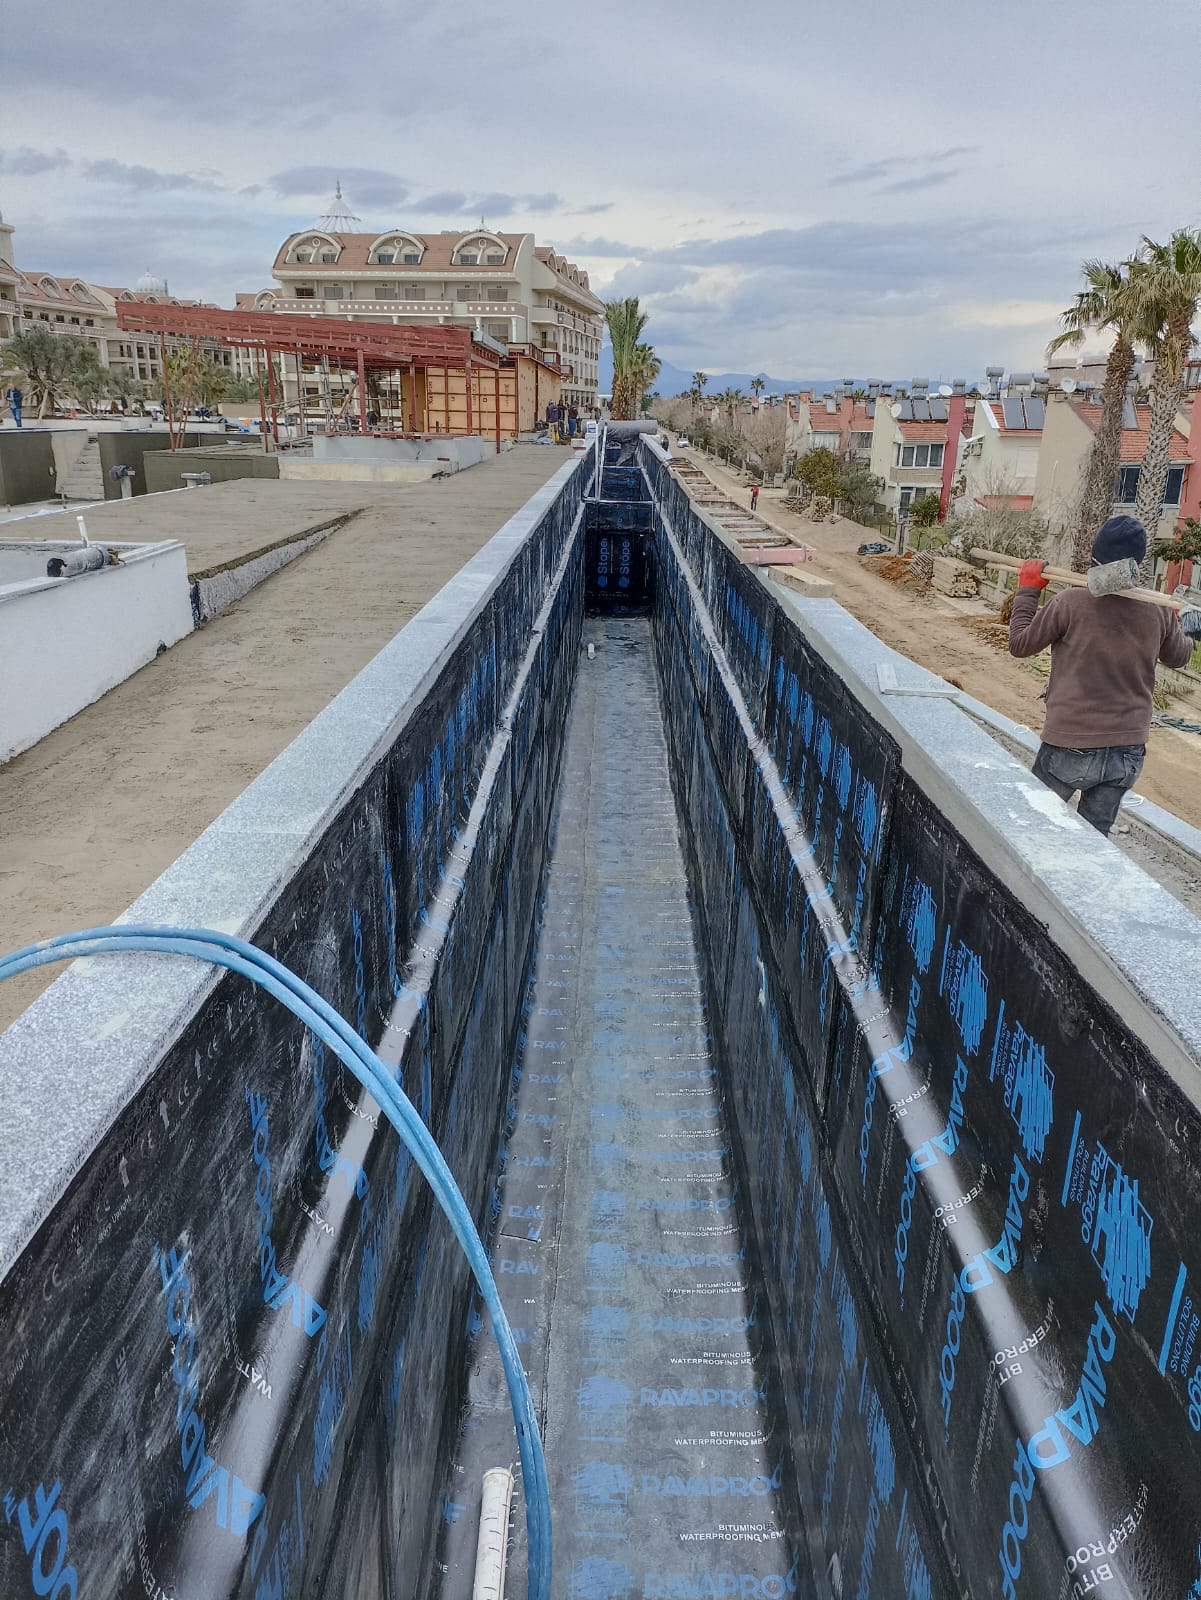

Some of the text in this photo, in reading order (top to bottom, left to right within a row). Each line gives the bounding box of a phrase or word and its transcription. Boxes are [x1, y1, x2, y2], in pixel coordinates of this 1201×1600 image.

[860, 974, 922, 1187] RAVAPROOF
[1003, 1019, 1024, 1108] Ravago
[895, 1054, 969, 1294] RAVAPROOF
[1069, 1137, 1085, 1202] SOLUTIONS
[1076, 1149, 1090, 1203] BUILDING
[1081, 1140, 1108, 1244] Ravago
[666, 1287, 730, 1295] WATERPROOFING
[939, 1154, 1030, 1428] RAVAPROOF
[670, 1358, 739, 1366] WATERPROOFING
[703, 1351, 751, 1359] BITUMINOUS
[984, 1297, 1056, 1408] WATERPROOFING
[1169, 1296, 1193, 1373] SOLUTIONS
[1180, 1312, 1200, 1377] BUILDING
[710, 1430, 762, 1438] BITUMINOUS
[986, 1362, 1024, 1451] BITUMINOUS
[674, 1438, 749, 1446] WATERPROOFING
[679, 1532, 760, 1542] WATERPROOFING
